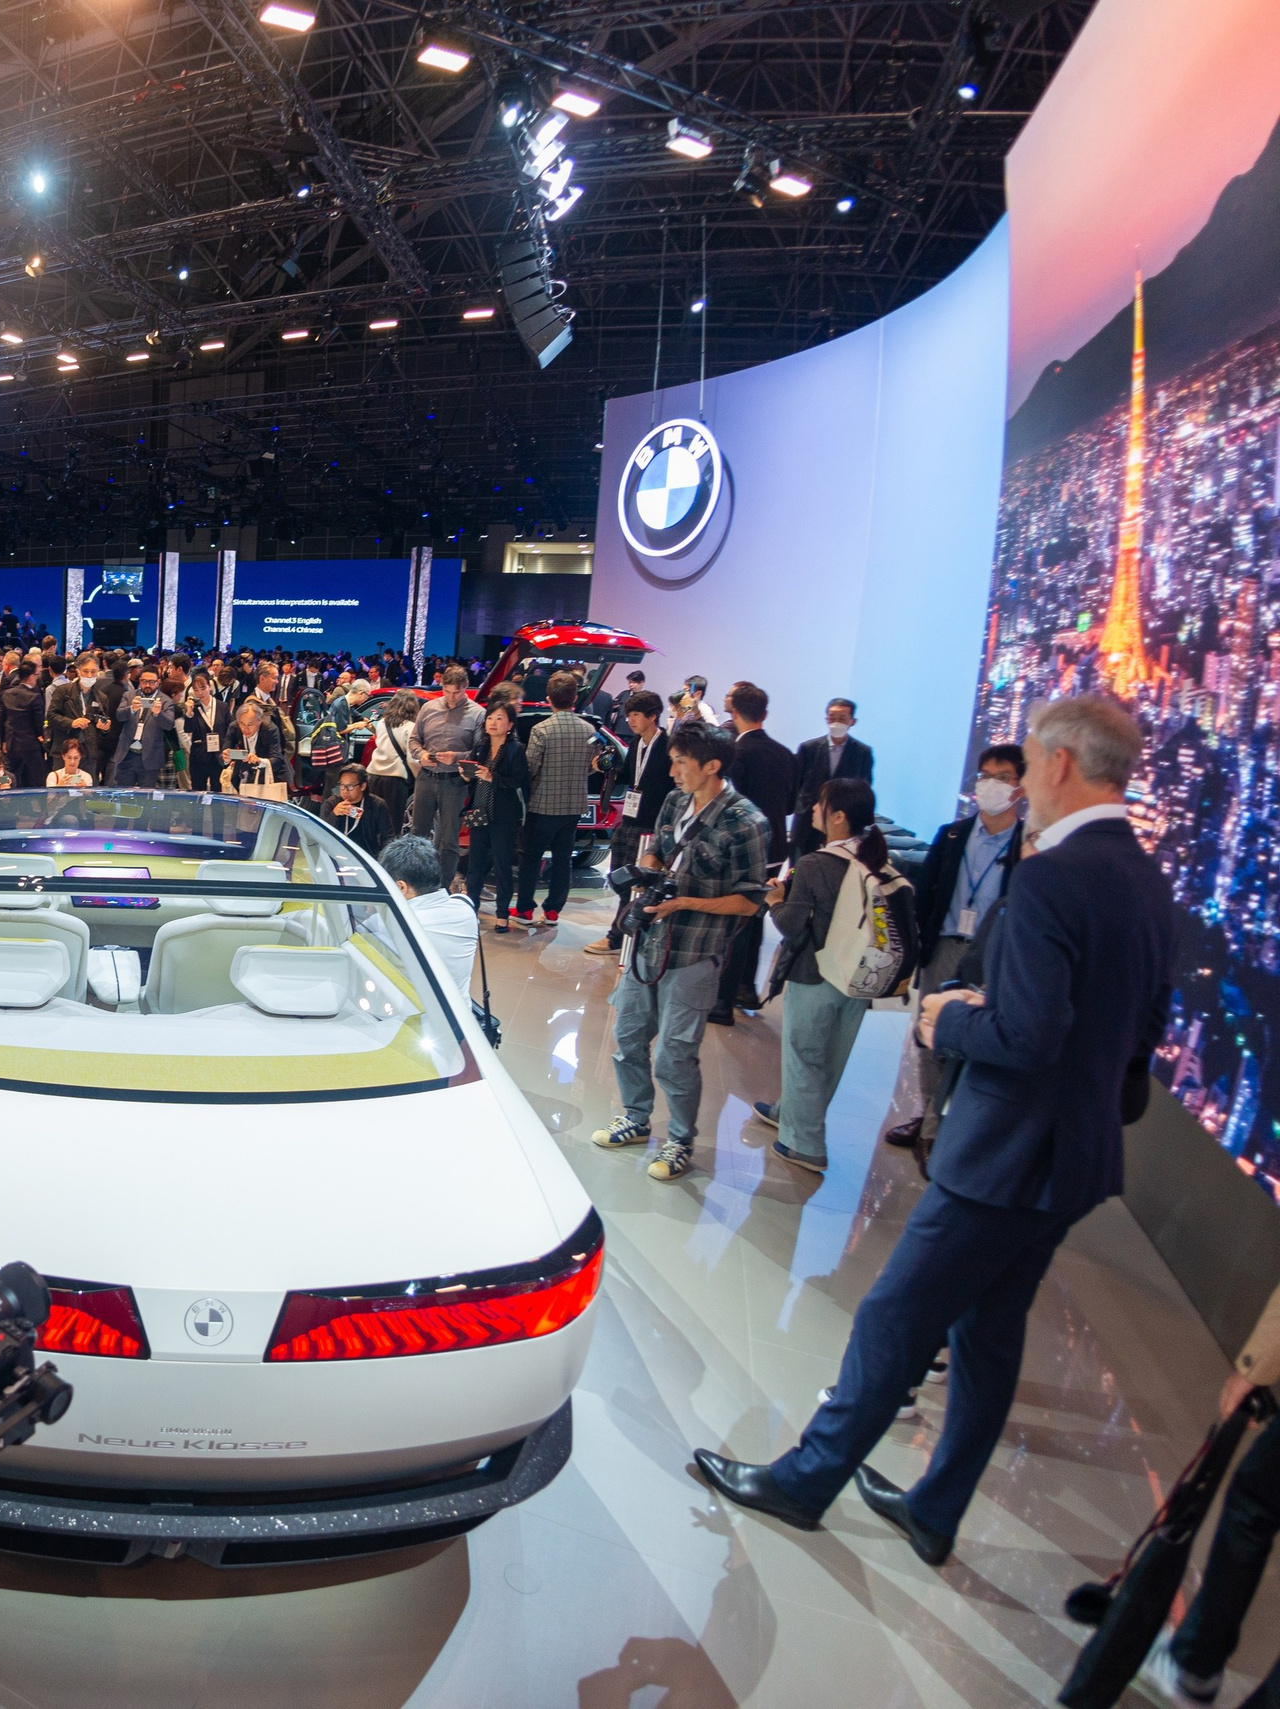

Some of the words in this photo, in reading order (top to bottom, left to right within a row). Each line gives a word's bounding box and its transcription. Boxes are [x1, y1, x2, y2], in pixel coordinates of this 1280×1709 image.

[634, 426, 710, 470] BMW
[297, 617, 322, 625] English
[191, 1299, 228, 1314] BMW
[78, 1433, 175, 1449] Neue
[182, 1439, 308, 1450] Klasse
